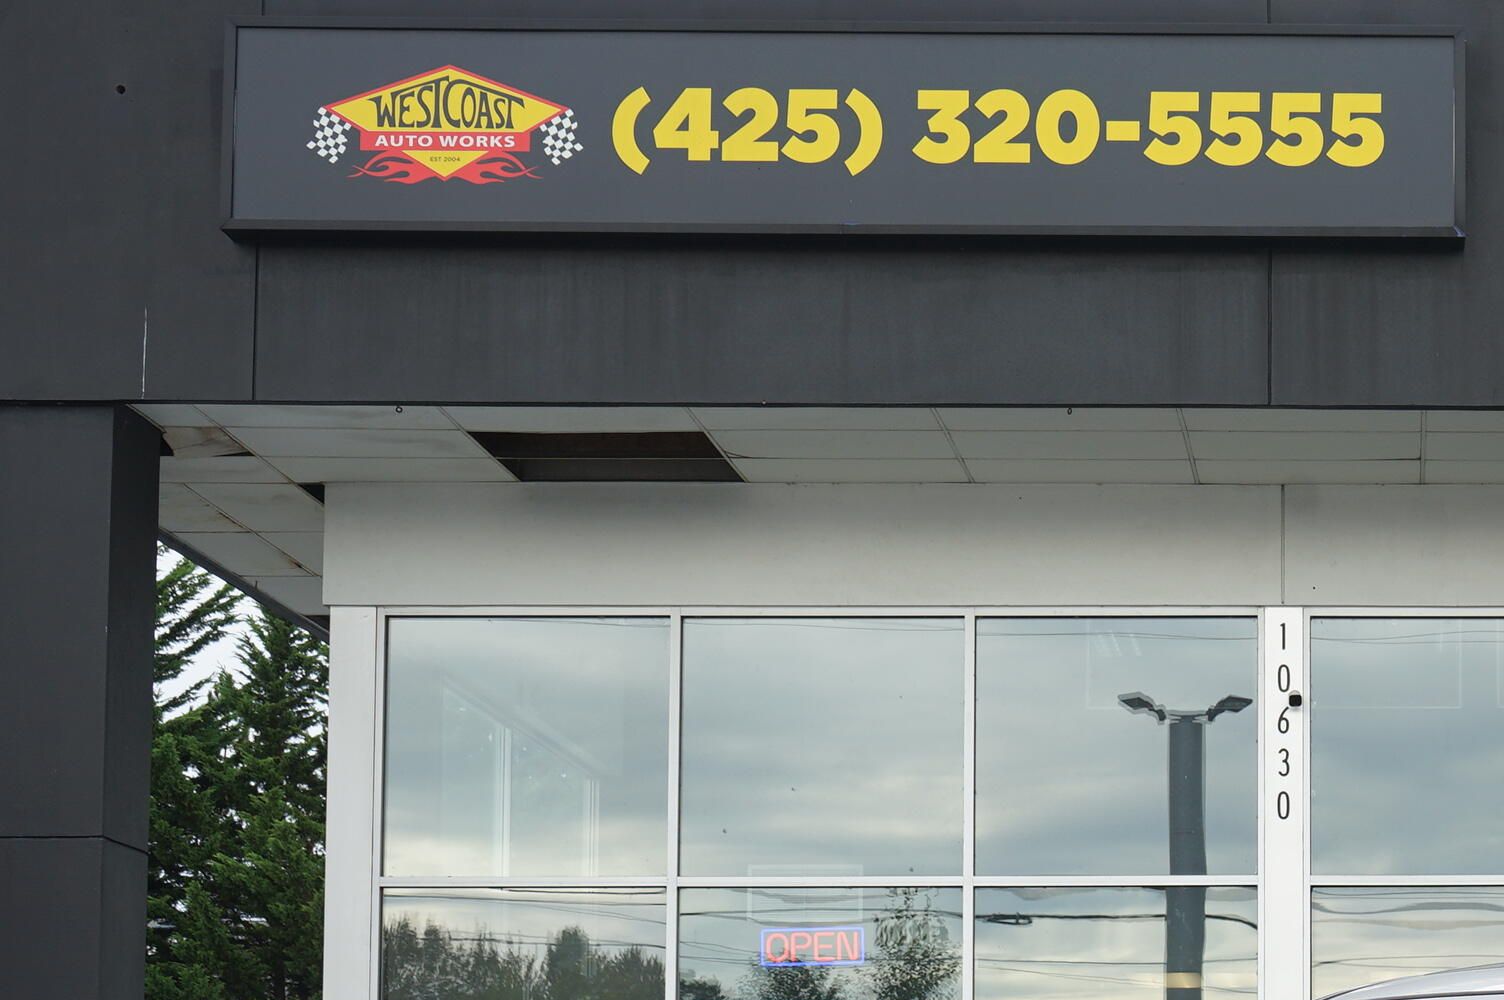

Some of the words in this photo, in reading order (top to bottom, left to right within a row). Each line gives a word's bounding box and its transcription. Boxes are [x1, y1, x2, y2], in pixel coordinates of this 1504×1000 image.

[375, 135, 432, 147] AUTO
[439, 135, 516, 148] WORKS
[612, 86, 883, 177] (425)
[911, 88, 1385, 167] 320-5555
[765, 931, 859, 963] OPEN
